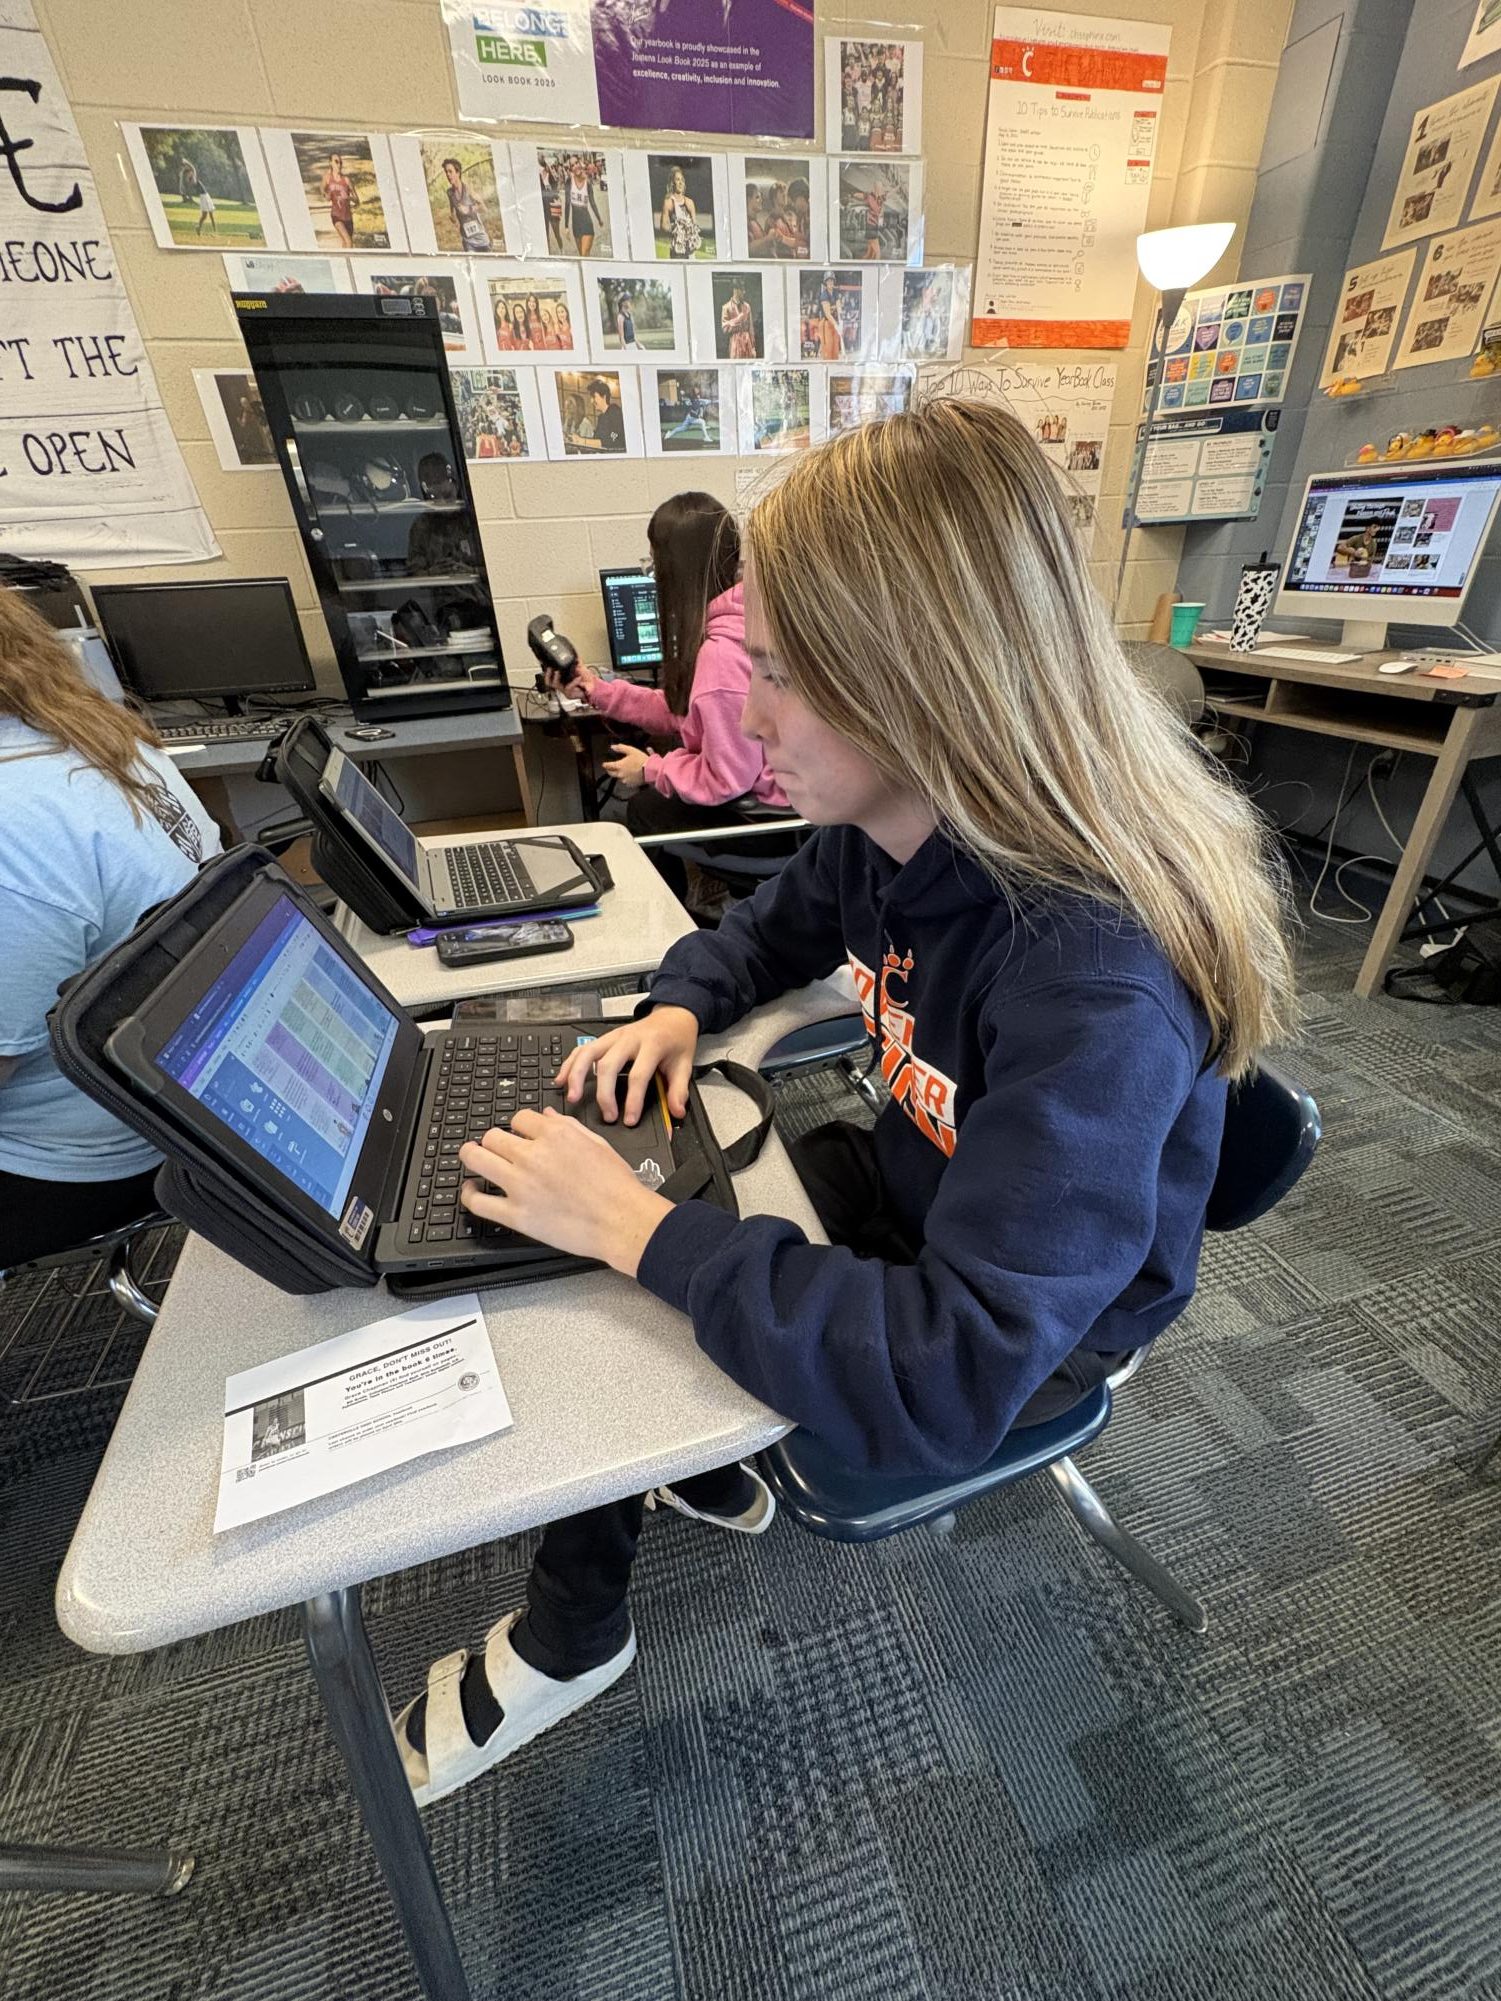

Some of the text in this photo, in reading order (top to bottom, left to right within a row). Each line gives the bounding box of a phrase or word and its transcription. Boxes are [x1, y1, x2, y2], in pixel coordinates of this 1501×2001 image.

[480, 40, 538, 63] HERE
[644, 38, 674, 49] yearbook
[675, 41, 681, 49] is
[682, 42, 705, 54] proudly
[706, 44, 741, 55] showcased
[743, 47, 748, 55] in
[750, 47, 760, 56] the
[657, 53, 672, 63] Look
[674, 55, 690, 66] Book
[692, 58, 709, 68] 2025
[711, 61, 718, 69] as
[720, 61, 728, 69] an
[729, 62, 753, 72] example
[755, 62, 761, 71] of
[482, 74, 505, 84] LOOK
[508, 76, 532, 86] BOOK
[633, 69, 781, 88] excellence, creativity, inclusion and innovation.
[1017, 101, 1028, 115] 10
[1031, 102, 1048, 120] Tips
[1052, 104, 1059, 117] to
[1415, 114, 1430, 143] 1
[0, 240, 112, 282] EONE
[1433, 244, 1444, 261] 6
[1347, 276, 1359, 292] 5
[0, 335, 138, 380] T THE
[967, 372, 993, 398] Ways
[997, 368, 1011, 391] To
[1013, 367, 1051, 390] Survive
[1093, 366, 1115, 389] Class
[23, 429, 136, 476] OPEN
[349, 1338, 452, 1382] GRACE, DON'T MISS OUT!
[344, 1379, 373, 1393] You're
[375, 1374, 384, 1382] in
[386, 1369, 399, 1378] the
[402, 1360, 422, 1371] book
